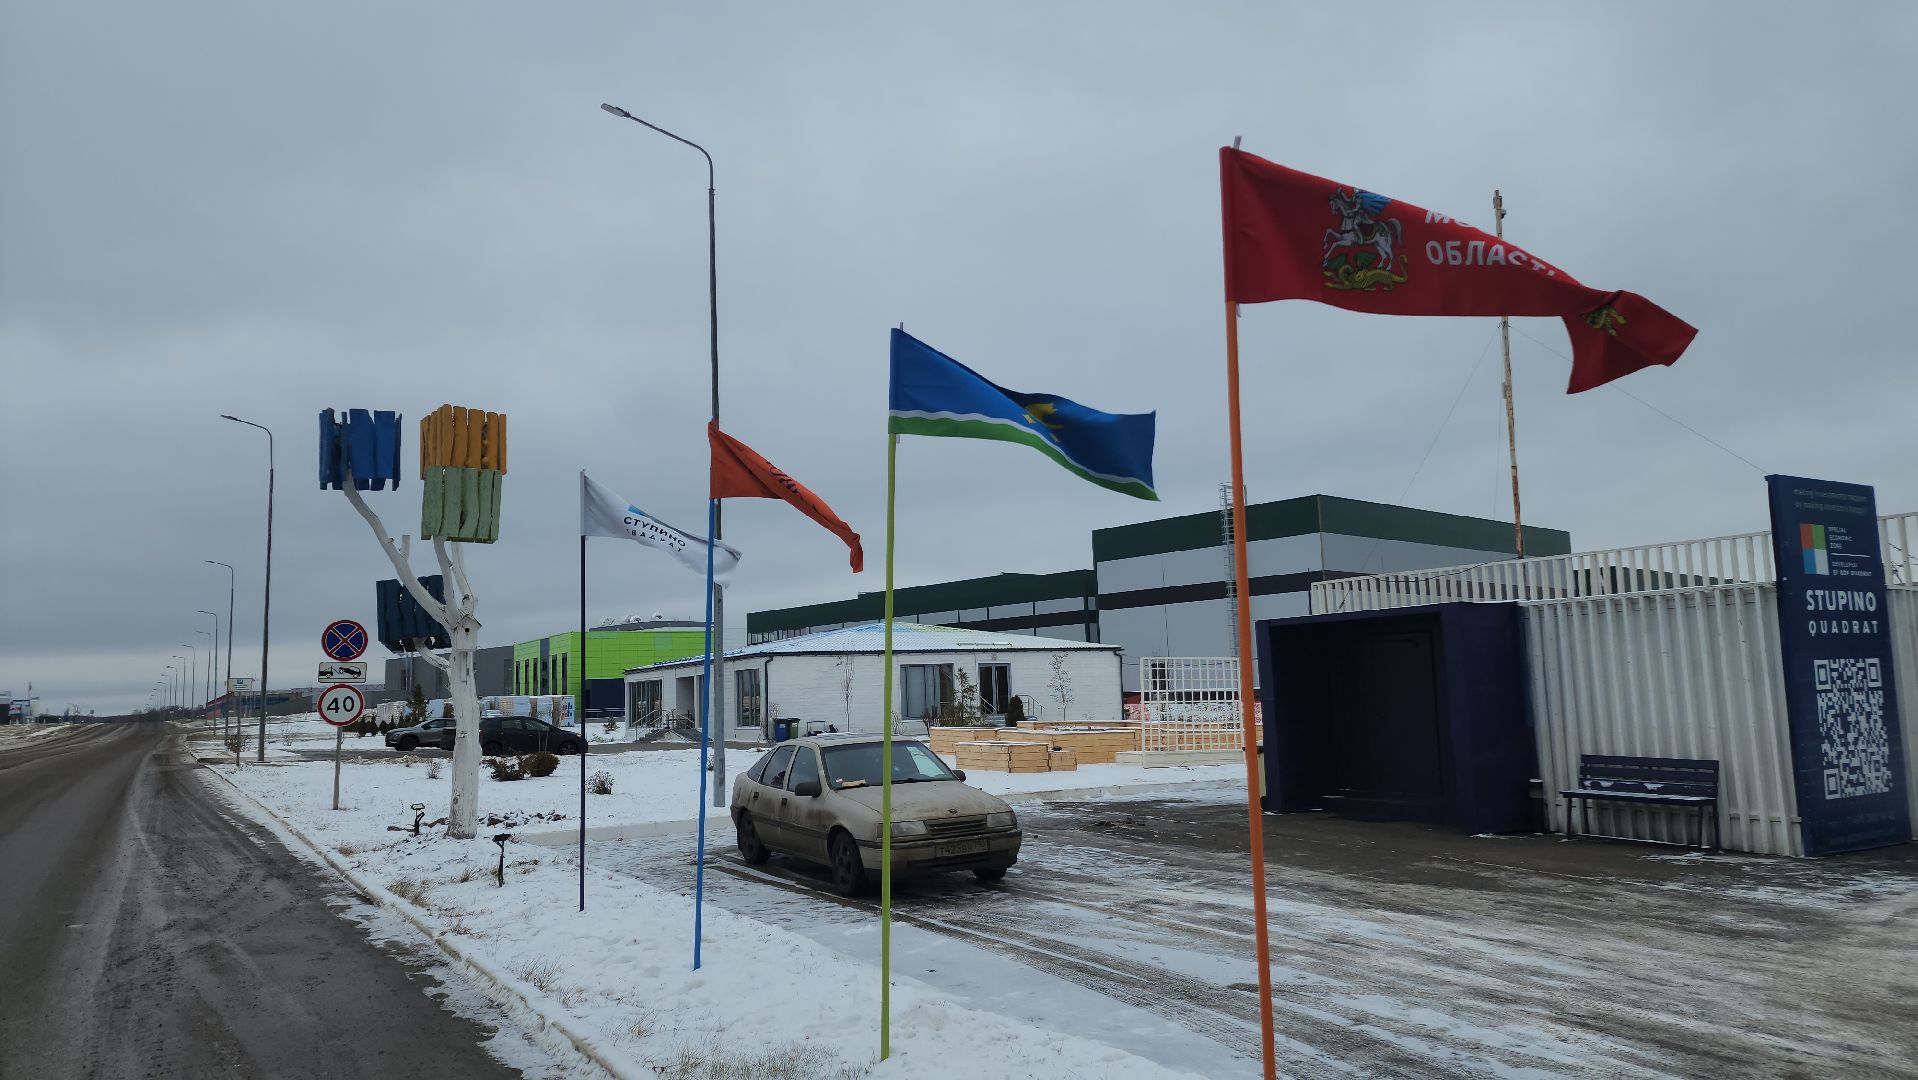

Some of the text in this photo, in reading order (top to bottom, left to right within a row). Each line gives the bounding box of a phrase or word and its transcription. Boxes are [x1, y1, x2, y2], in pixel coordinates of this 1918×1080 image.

[623, 516, 686, 547] СТУПИНО
[1806, 589, 1877, 612] STUPINO
[1808, 620, 1878, 637] QUADRAT
[326, 695, 355, 714] 40
